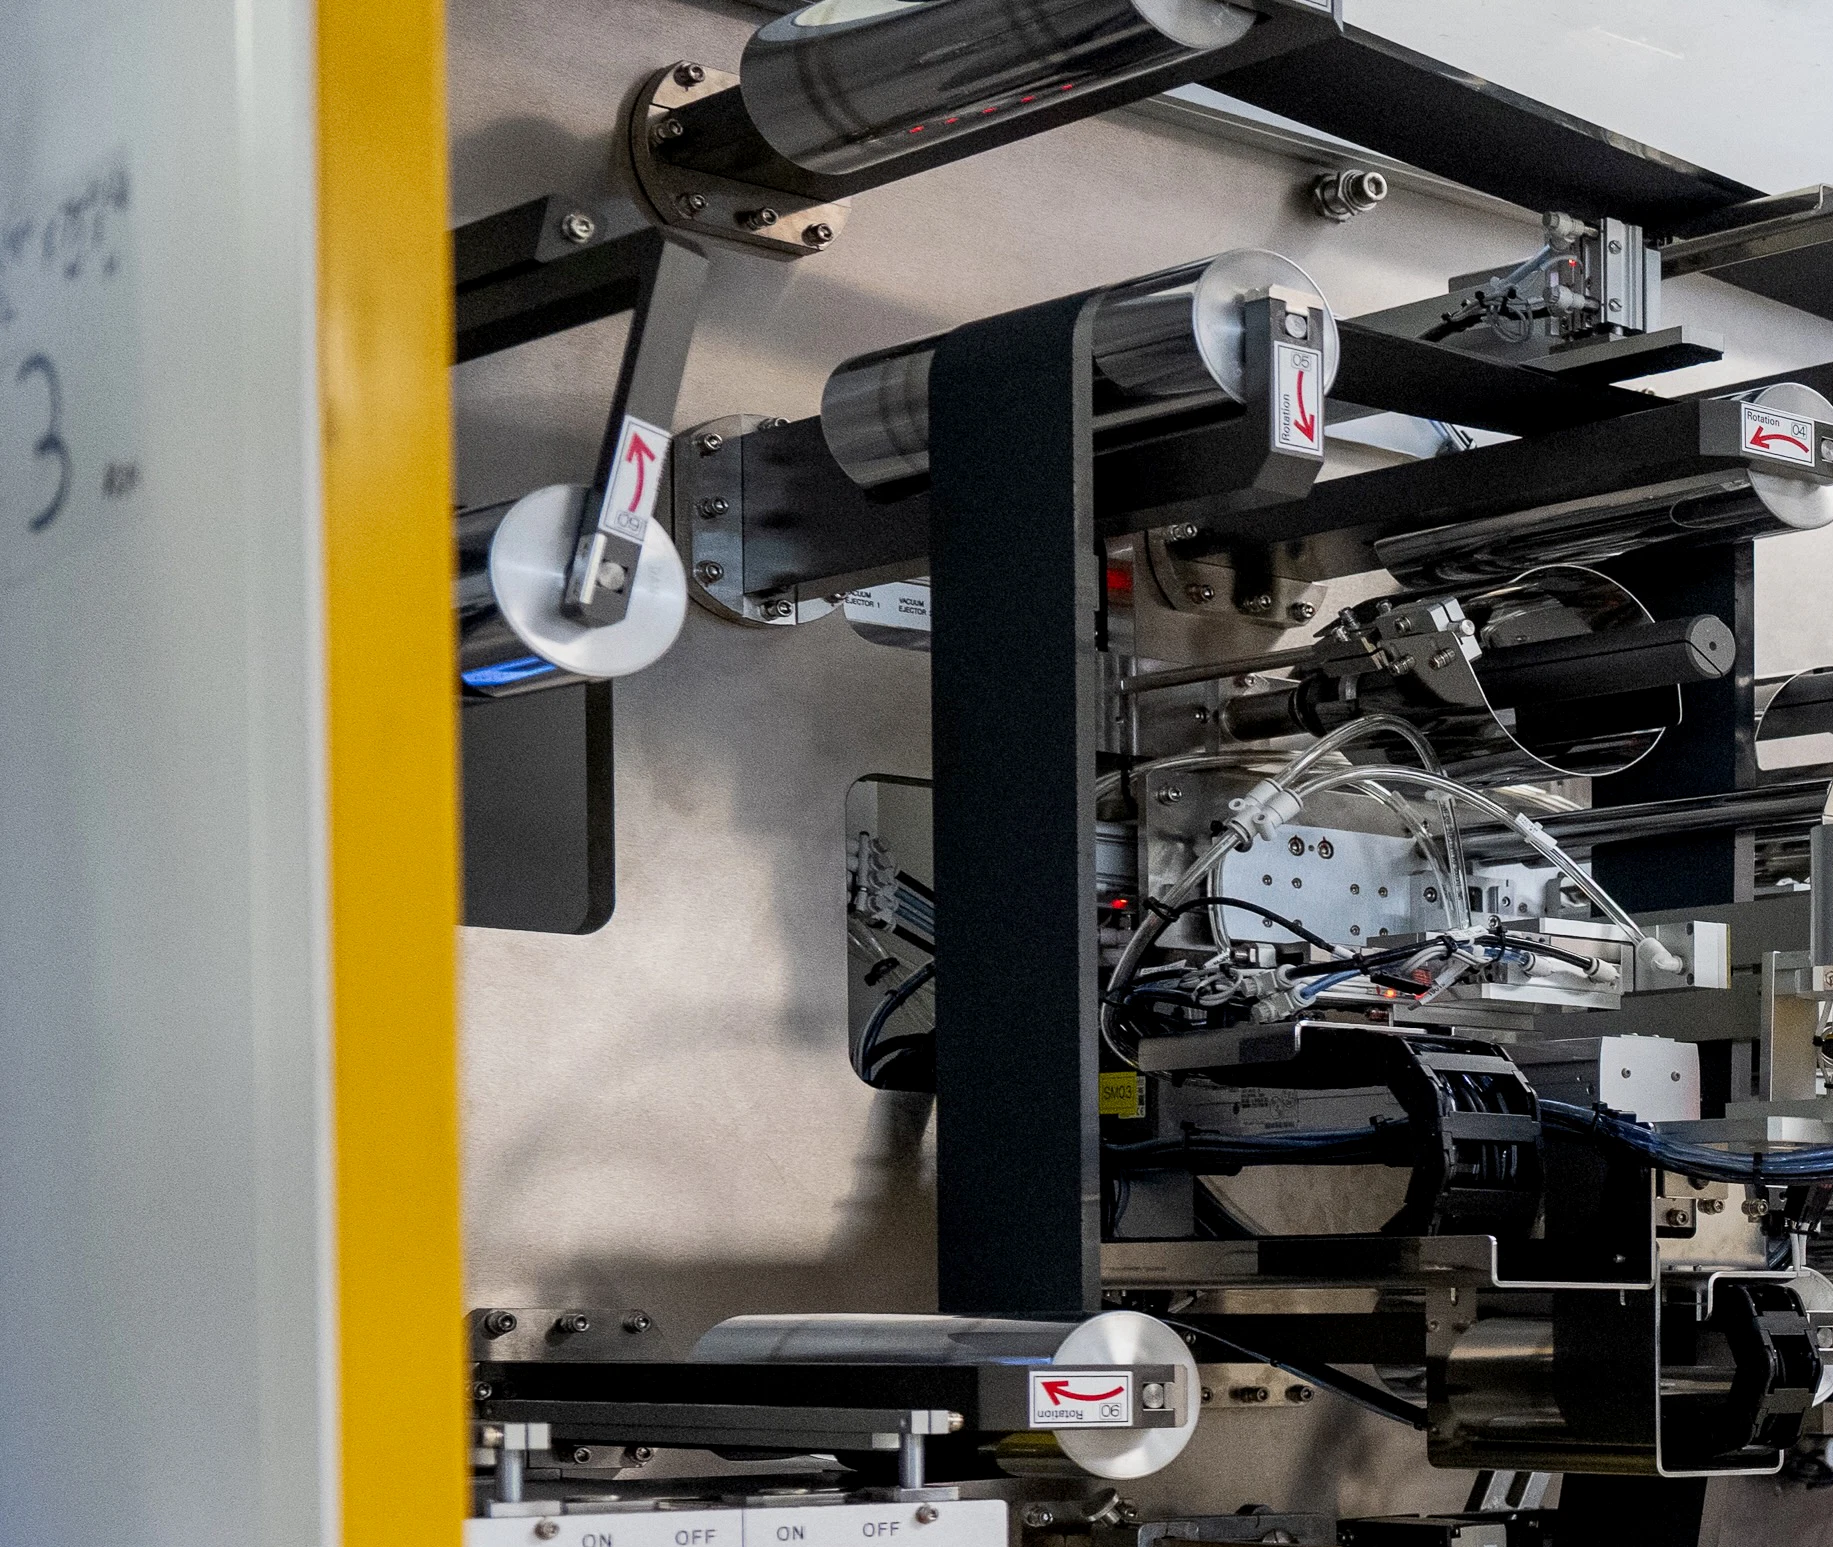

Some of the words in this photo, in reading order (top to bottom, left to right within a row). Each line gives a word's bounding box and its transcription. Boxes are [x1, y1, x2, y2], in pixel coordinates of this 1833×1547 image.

[1292, 352, 1310, 369] 05
[1281, 393, 1291, 442] Rotation
[1746, 410, 1781, 427] Rotation
[1792, 423, 1806, 438] 04
[845, 597, 875, 608] EJECTOR
[898, 597, 926, 607] VACUUM
[898, 605, 928, 616] EJECTOR
[1036, 1409, 1084, 1420] Rotation
[1101, 1404, 1120, 1418] 06
[674, 1528, 717, 1546] OFF
[776, 1526, 805, 1542] ON
[862, 1521, 901, 1538] OFF
